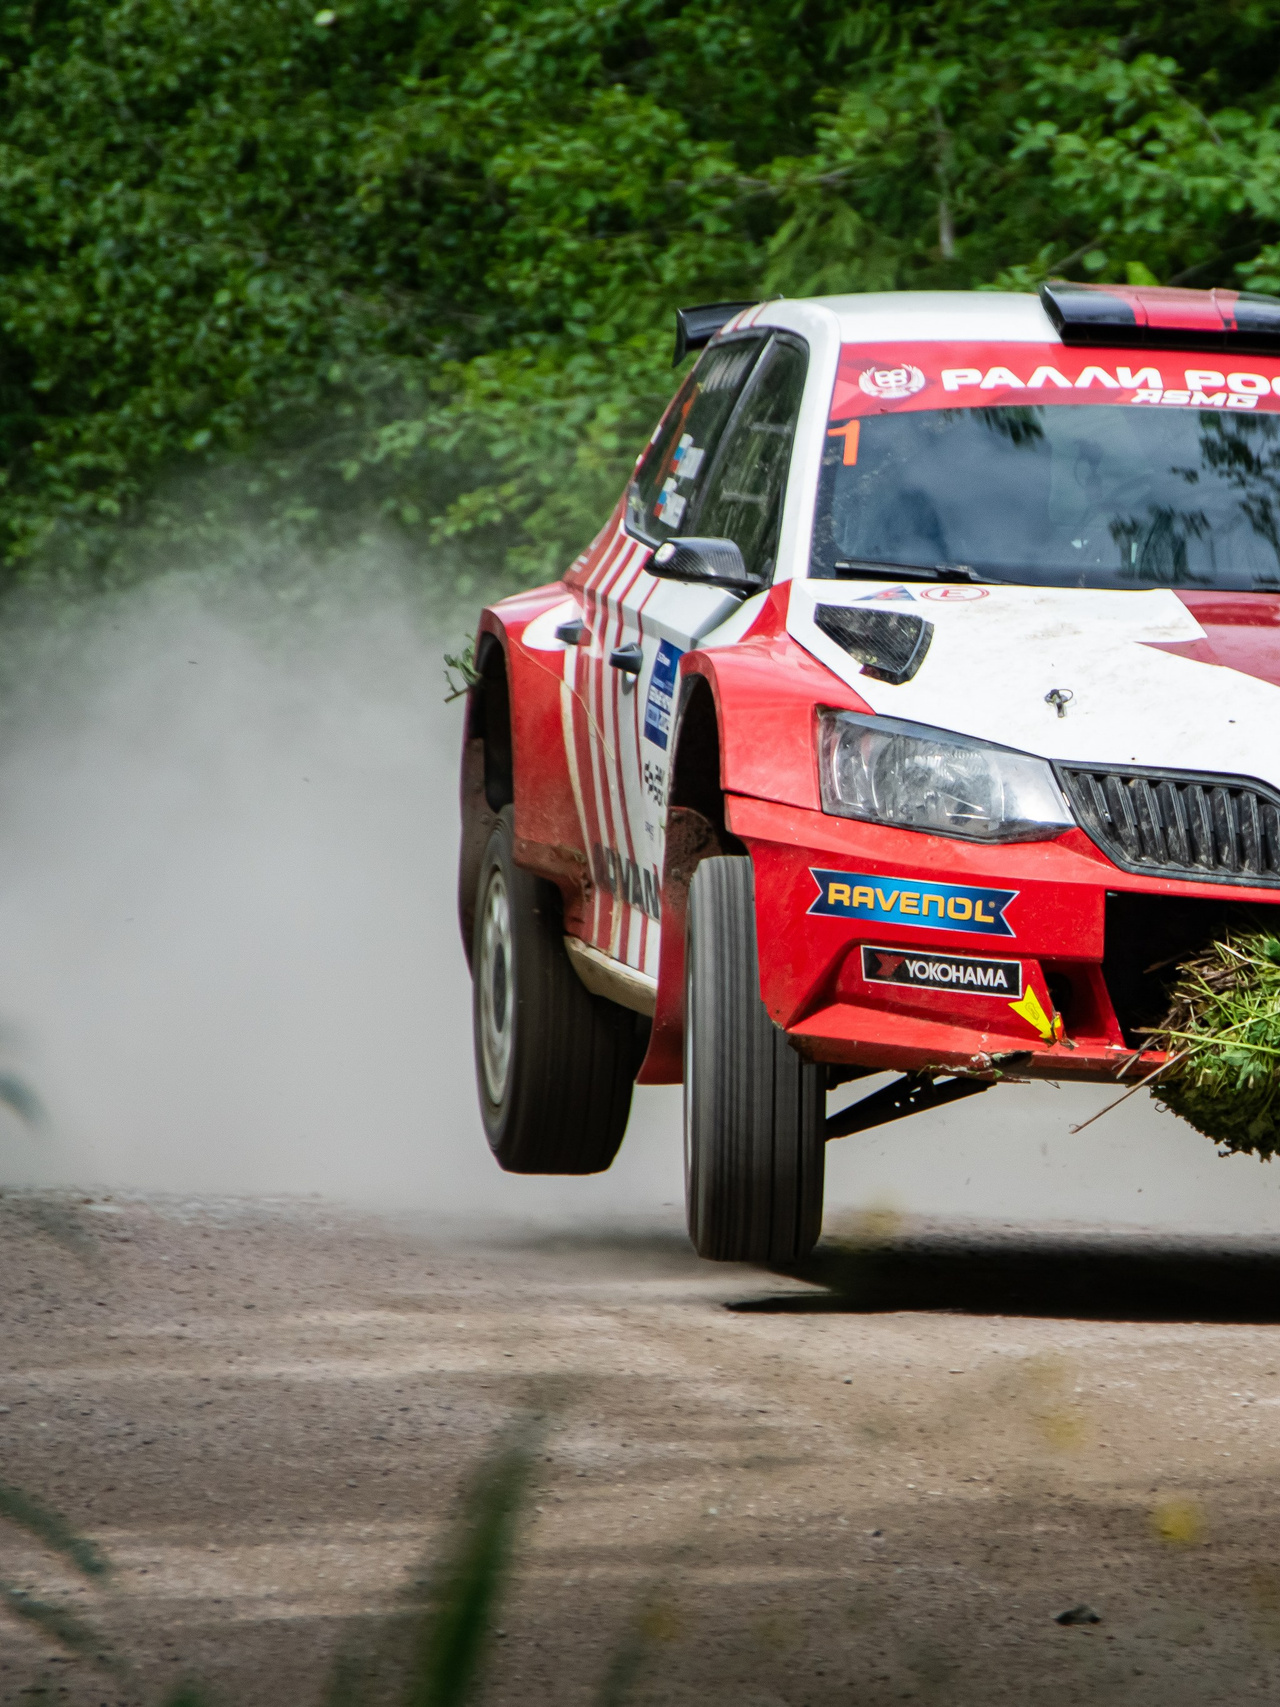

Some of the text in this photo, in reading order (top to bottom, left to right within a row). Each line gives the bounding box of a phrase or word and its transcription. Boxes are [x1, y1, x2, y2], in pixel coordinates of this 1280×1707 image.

[827, 419, 860, 467] 1
[827, 882, 994, 924] RAVENOL
[905, 959, 1009, 989] YOKOHAMA
